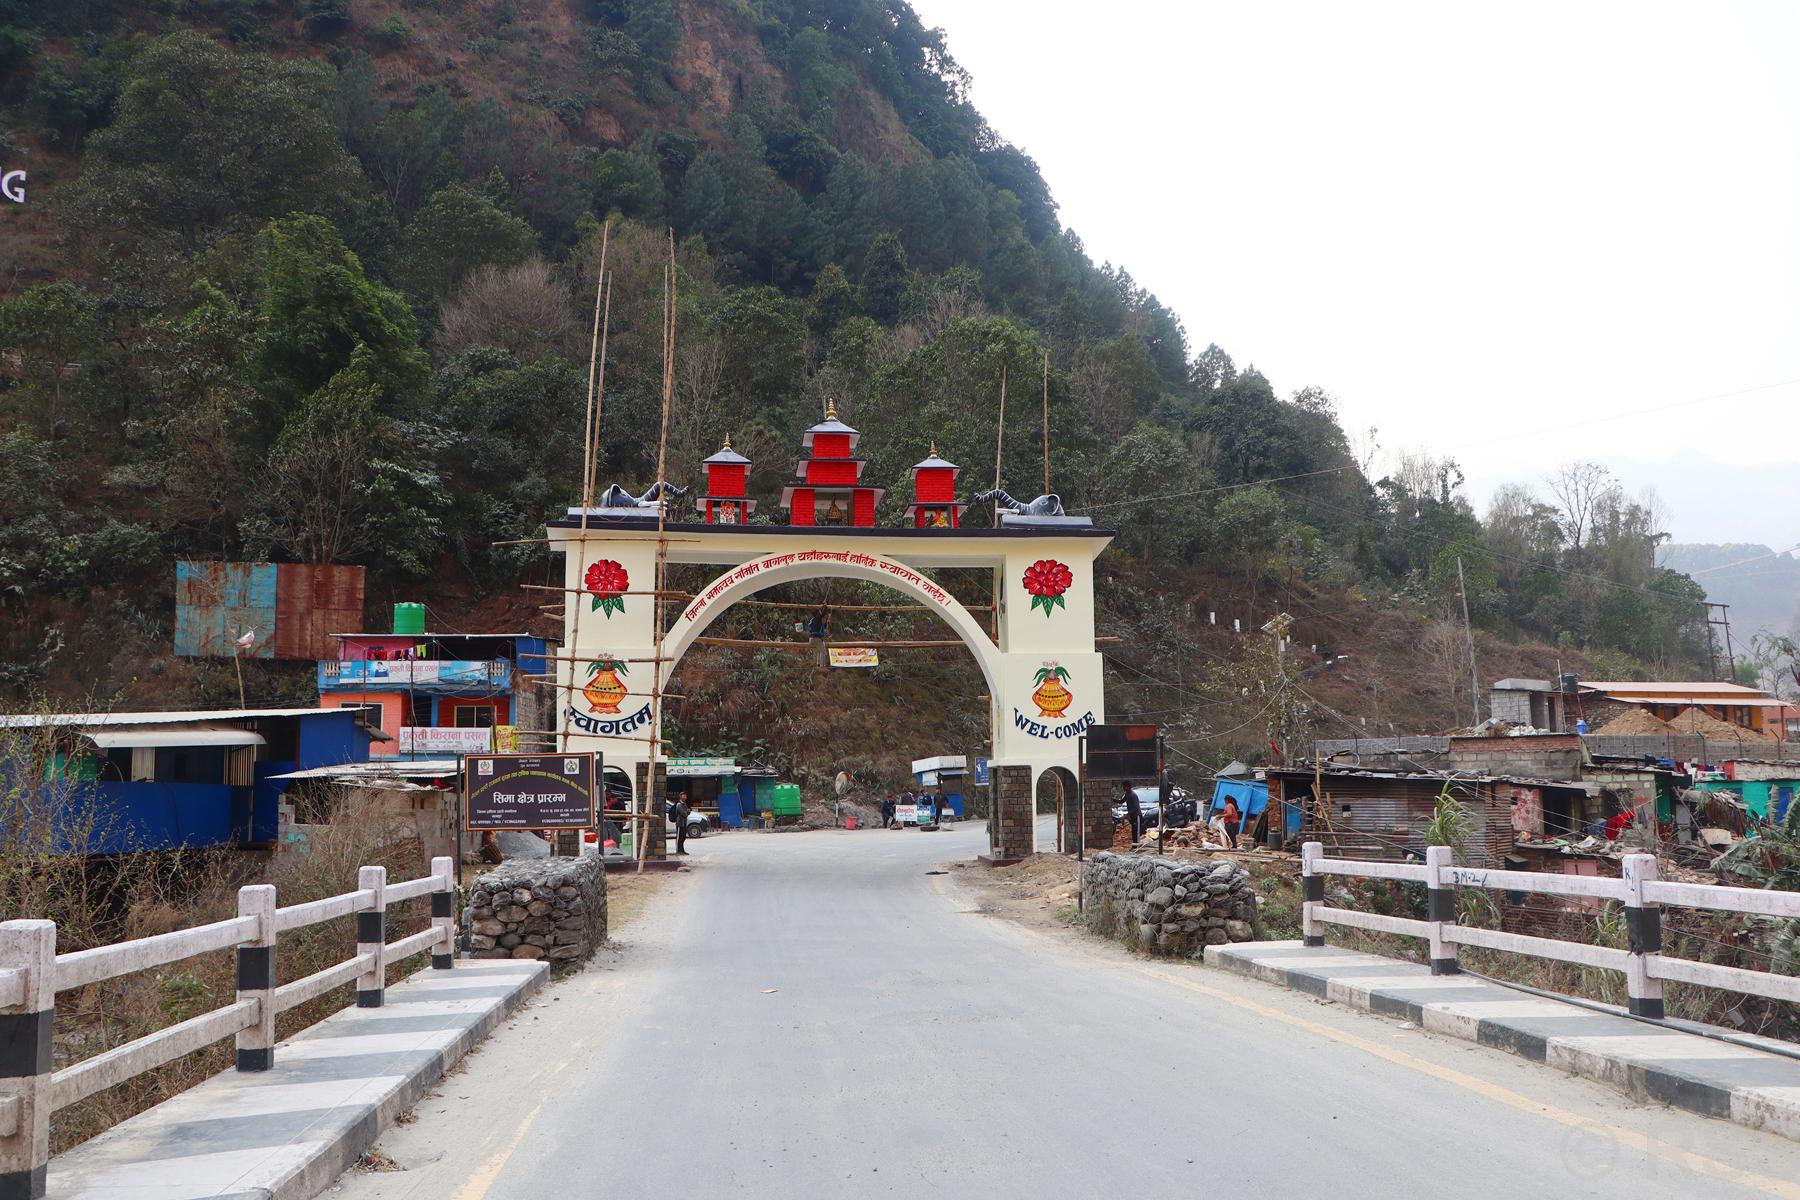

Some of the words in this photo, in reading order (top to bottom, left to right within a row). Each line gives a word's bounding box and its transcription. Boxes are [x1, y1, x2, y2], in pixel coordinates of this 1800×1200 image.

[685, 597, 707, 622] जिल्ला
[734, 563, 760, 580] समिति
[879, 560, 922, 585] स्वागत
[1013, 707, 1096, 740] WEL-COME
[493, 791, 515, 804] सिमा
[517, 791, 535, 804] क्षेत्र
[537, 793, 567, 804] प्रारम्भ
